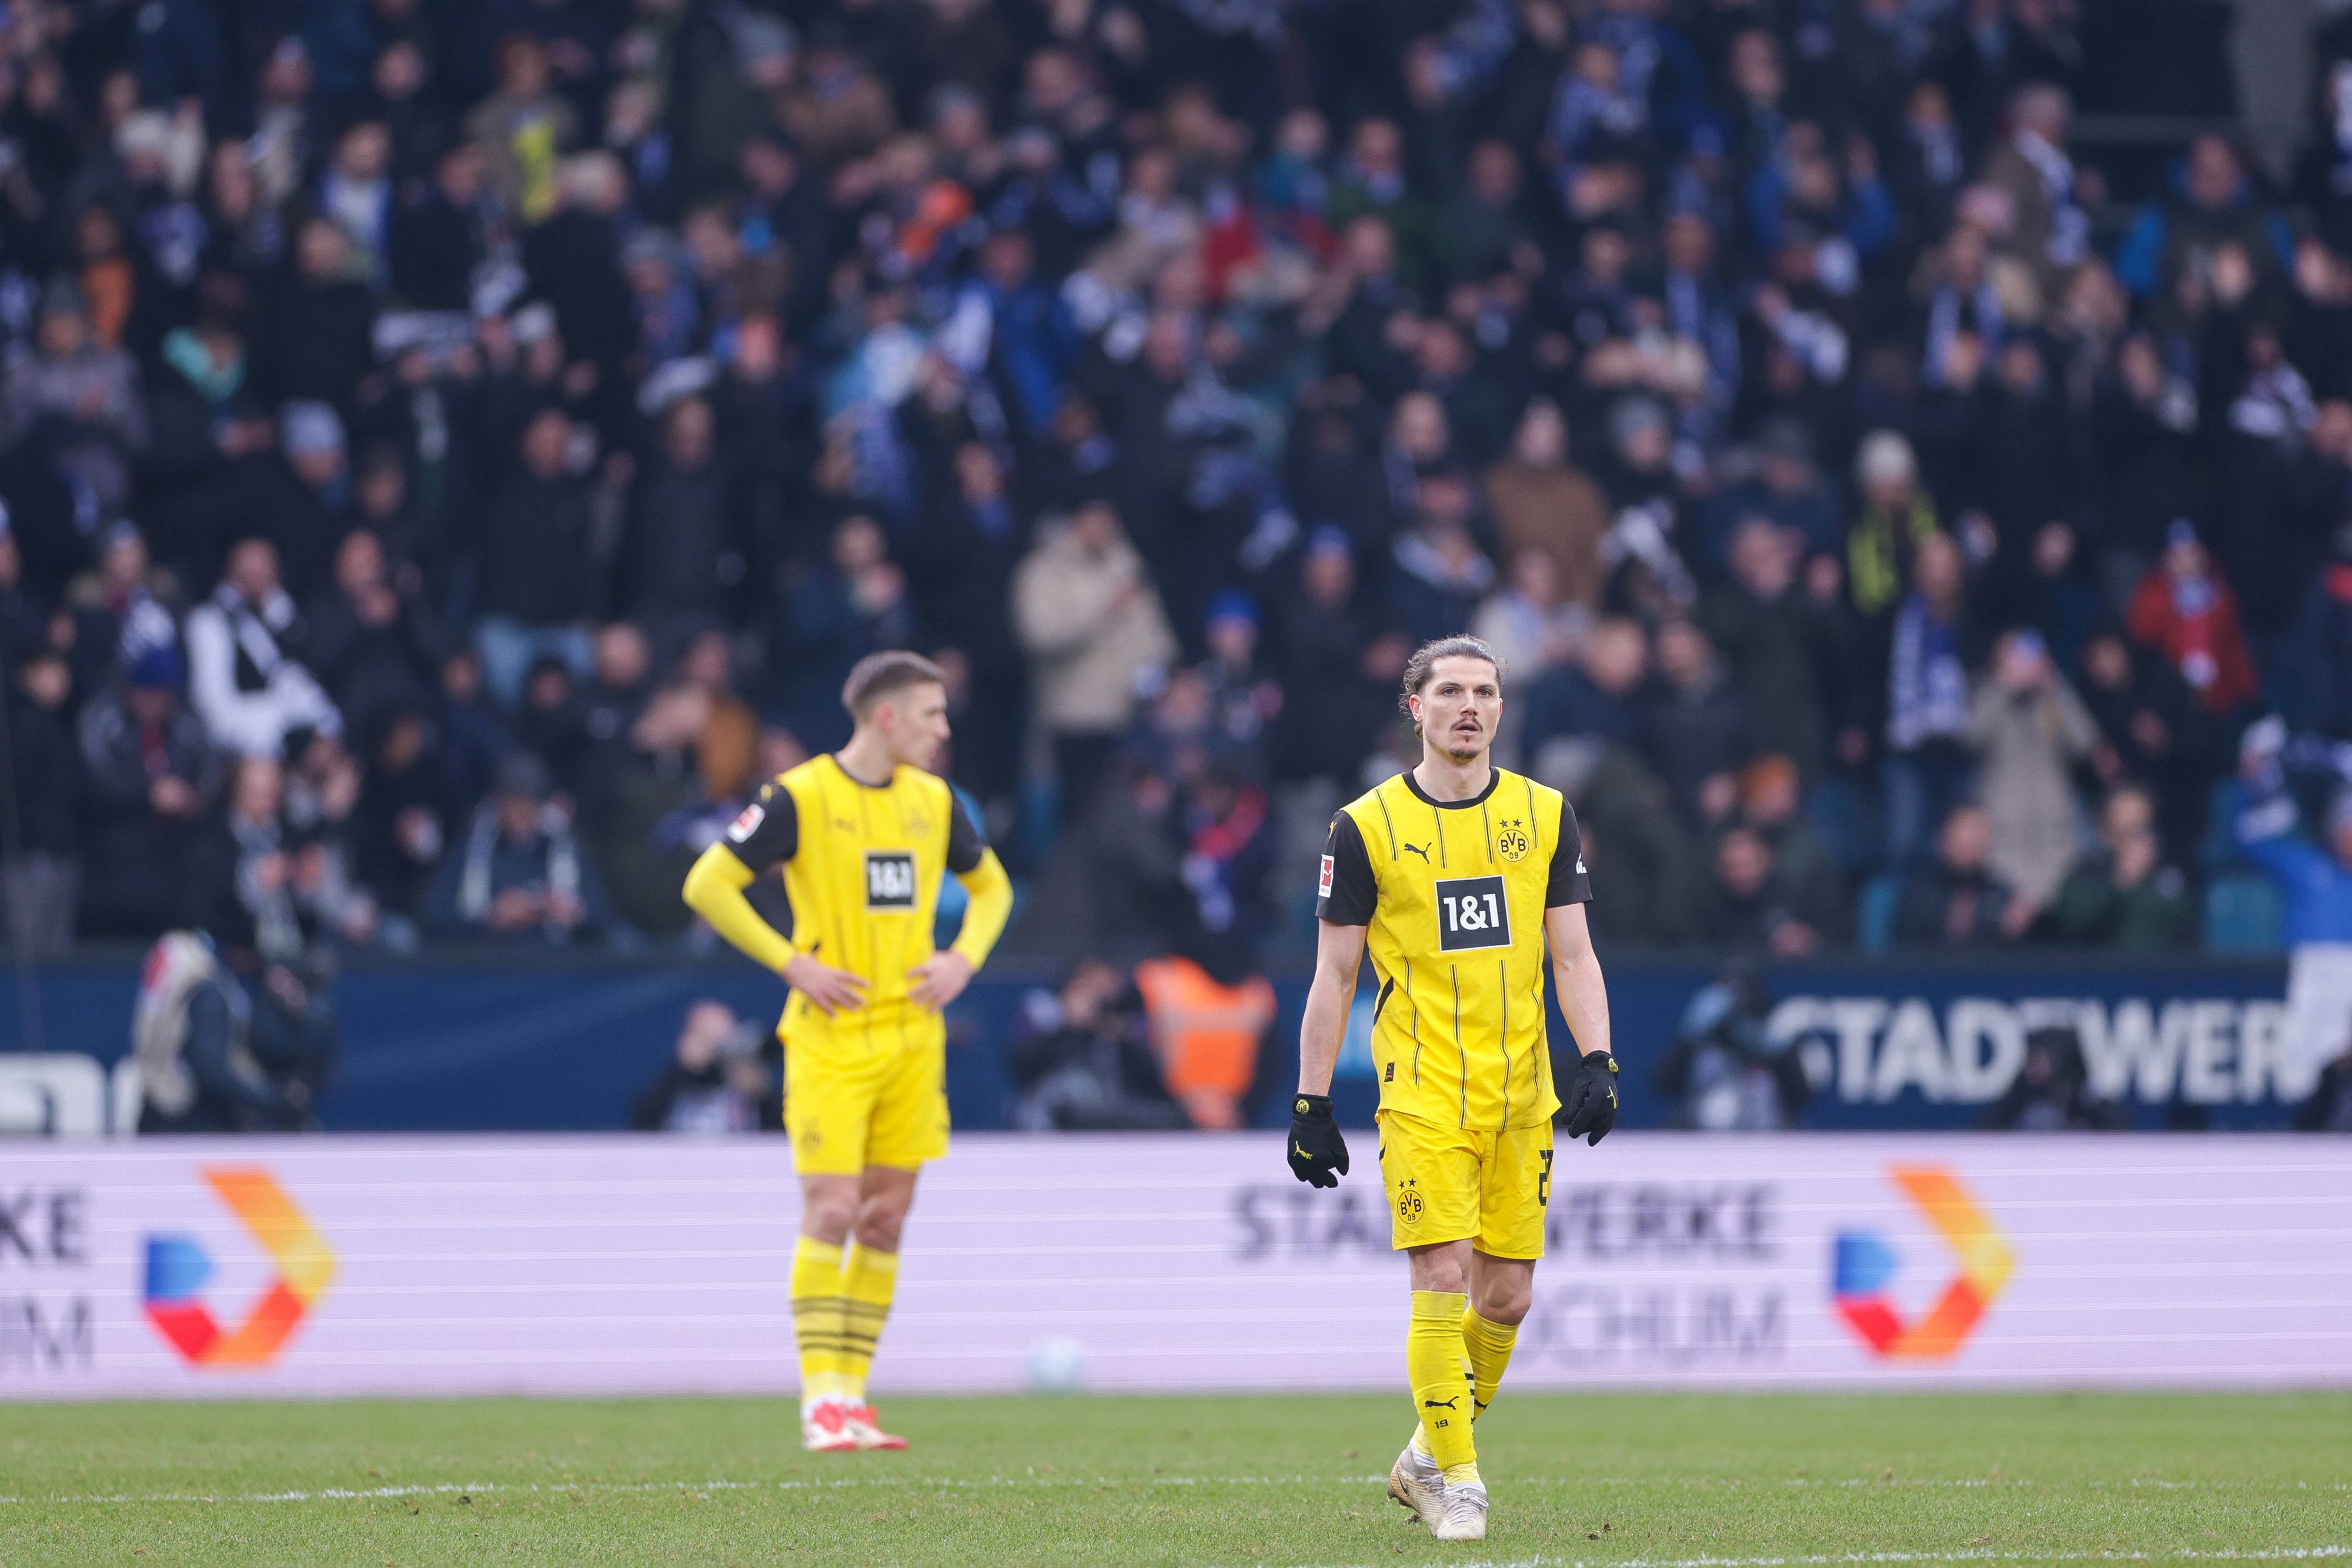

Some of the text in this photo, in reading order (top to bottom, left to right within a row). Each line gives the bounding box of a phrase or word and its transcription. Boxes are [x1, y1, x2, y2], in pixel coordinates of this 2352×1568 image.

[1501, 833, 1526, 852] BVB
[867, 861, 911, 898] 1&1
[1443, 894, 1500, 932] 1&1
[1400, 1193, 1422, 1215] BVB
[1408, 1213, 1416, 1221] 09
[1435, 1419, 1448, 1429] 19
